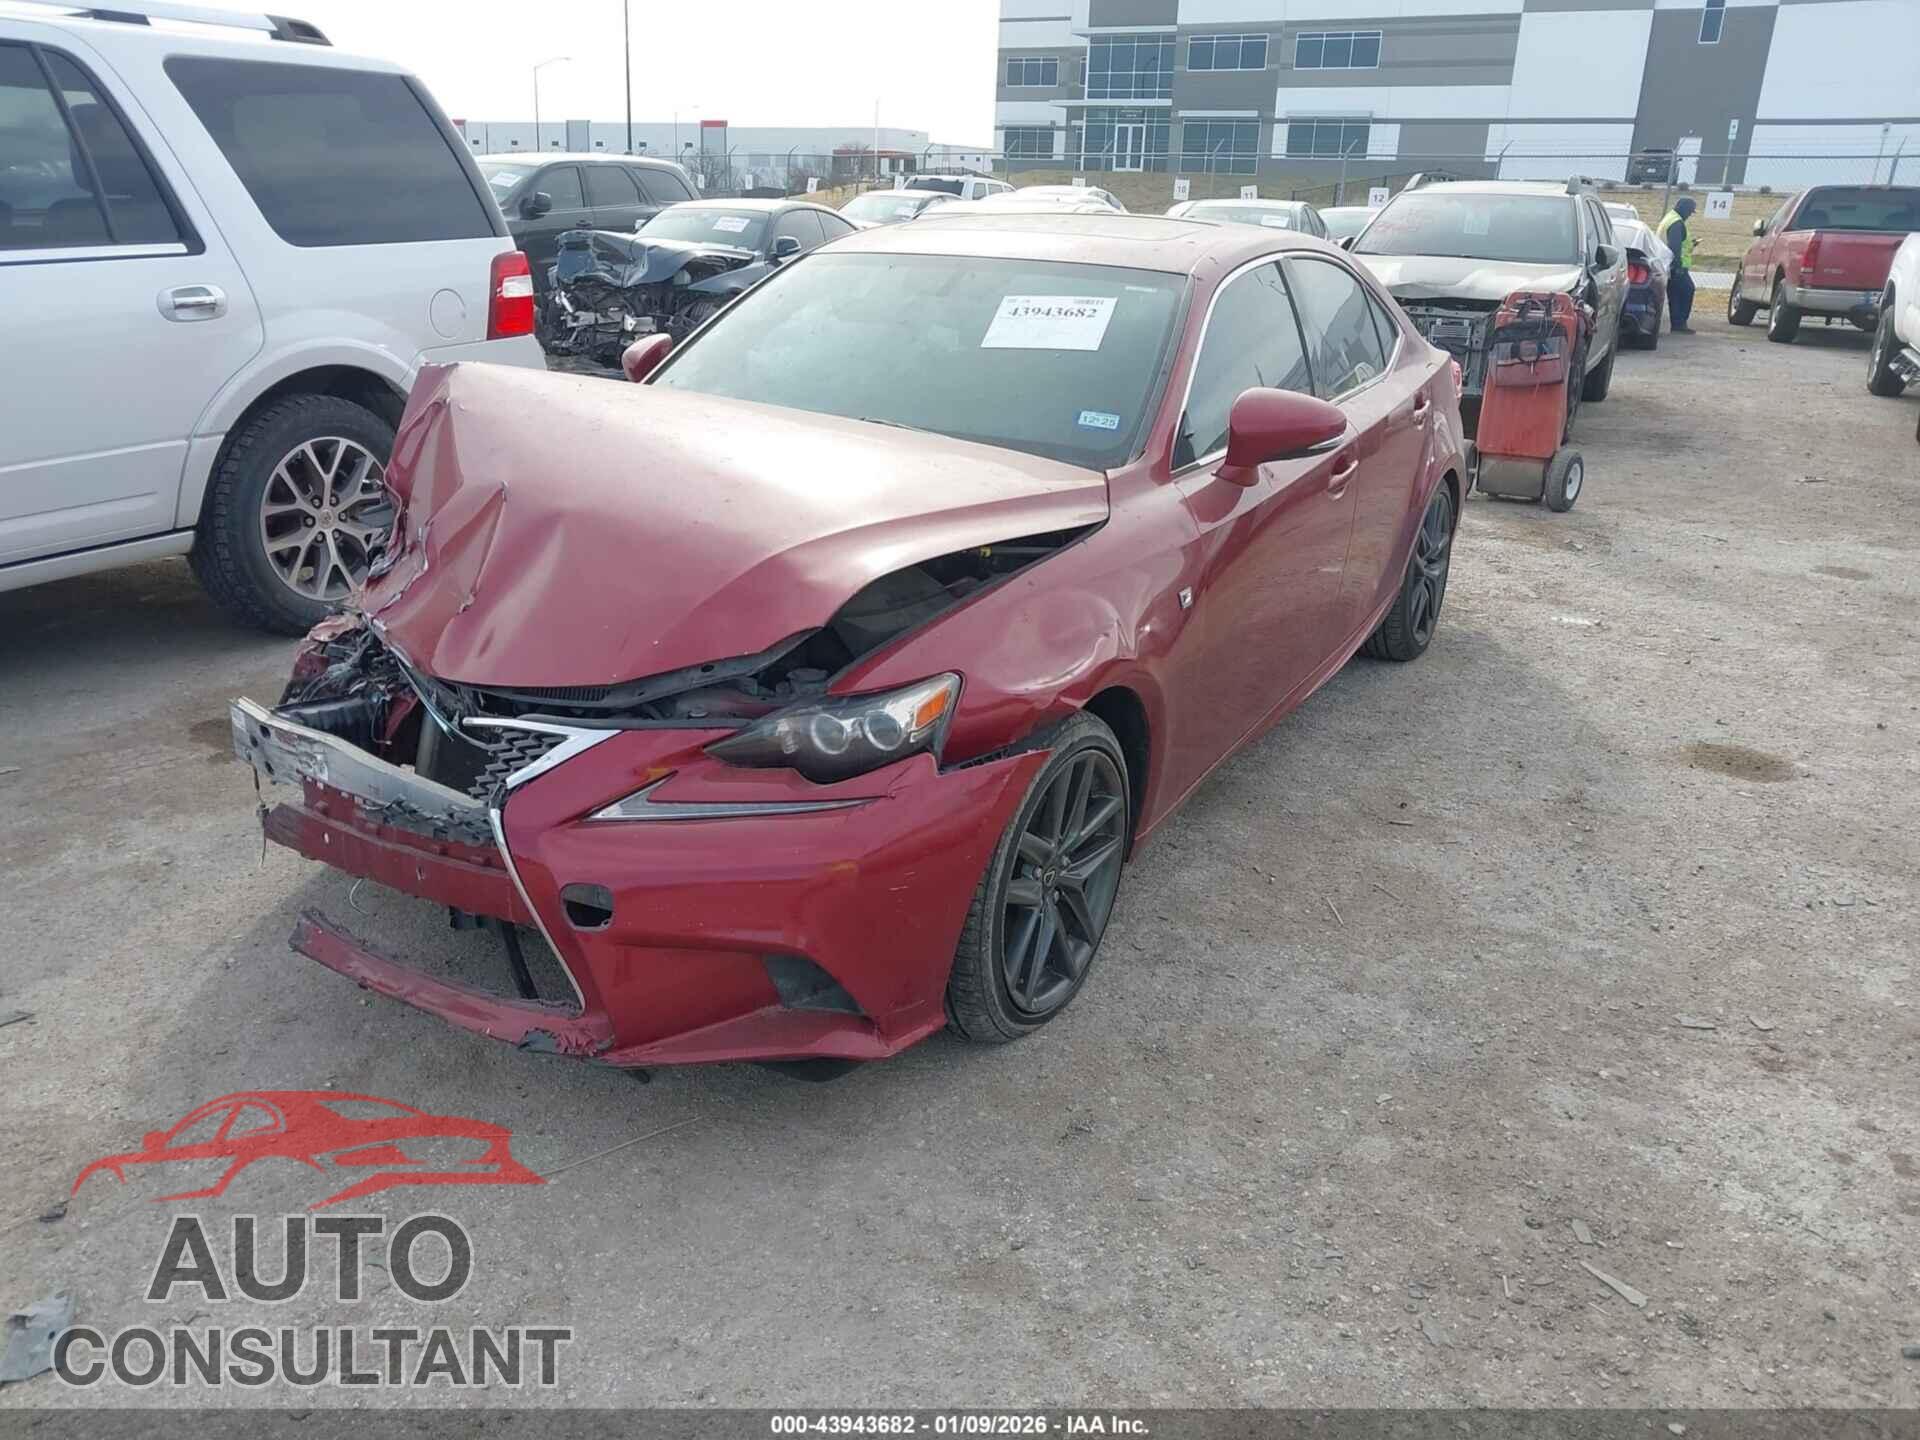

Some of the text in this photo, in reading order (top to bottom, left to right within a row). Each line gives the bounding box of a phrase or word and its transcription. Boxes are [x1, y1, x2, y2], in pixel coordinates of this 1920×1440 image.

[1373, 193, 1385, 203] 12
[1712, 200, 1727, 209] 14
[1007, 306, 1097, 318] 43943682
